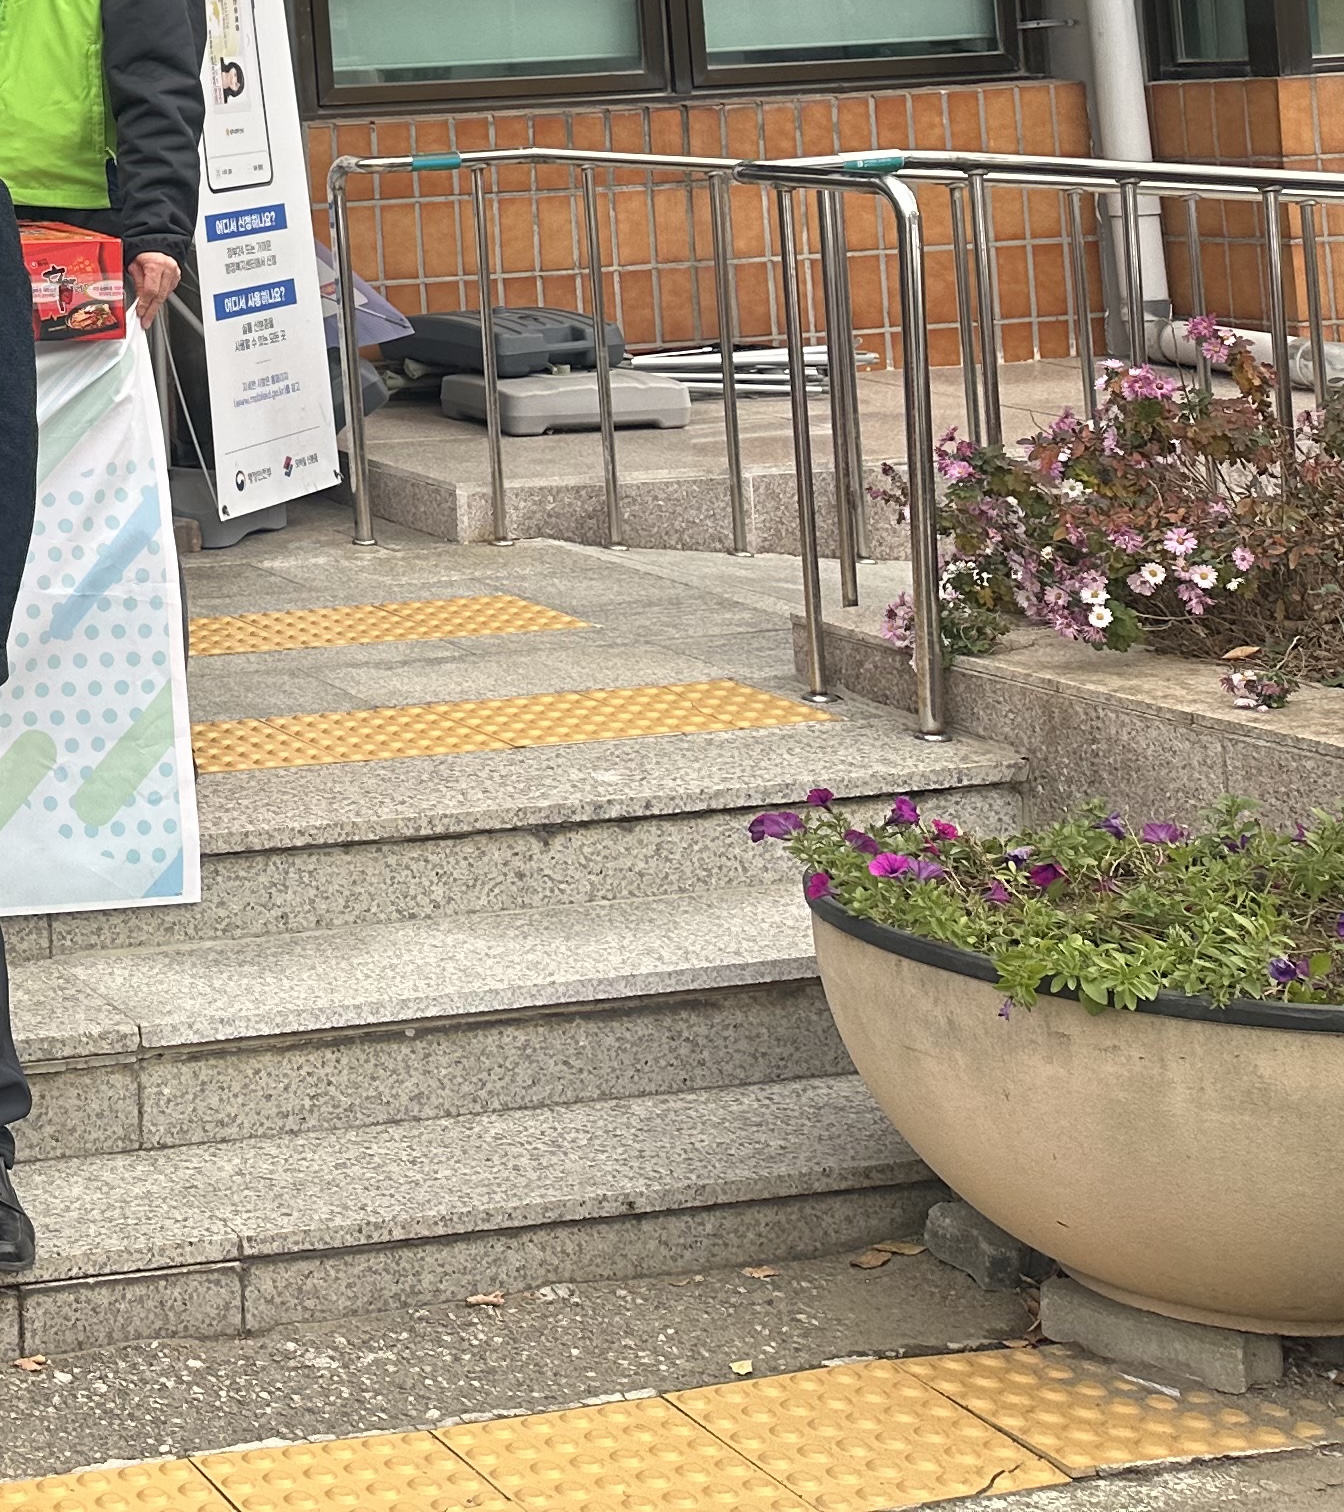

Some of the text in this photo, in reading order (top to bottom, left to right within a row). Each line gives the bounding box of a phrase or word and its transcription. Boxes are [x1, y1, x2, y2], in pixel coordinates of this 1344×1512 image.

[216, 212, 276, 235] 어디서 신청하나요?
[224, 286, 286, 313] 어디서 사용하나요?
